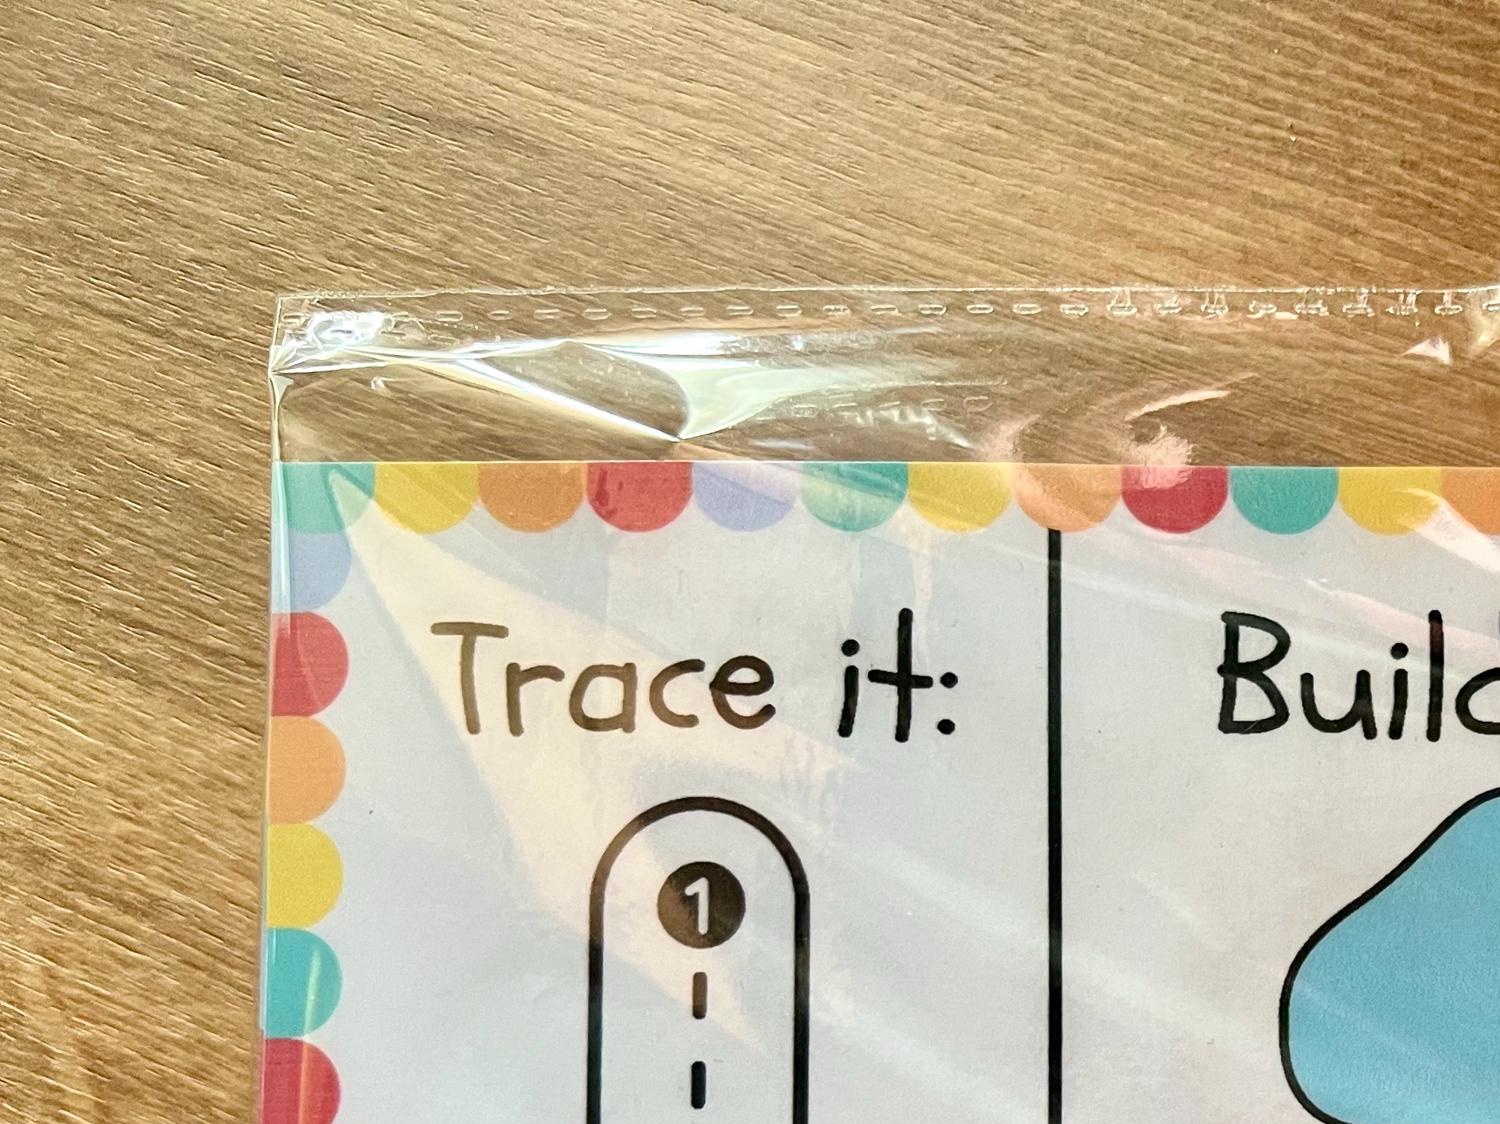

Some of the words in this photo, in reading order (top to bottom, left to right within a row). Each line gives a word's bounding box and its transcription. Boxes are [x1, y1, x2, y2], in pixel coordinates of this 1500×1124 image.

[431, 621, 776, 737] Trace
[837, 607, 958, 744] it:
[684, 877, 710, 936] 1
